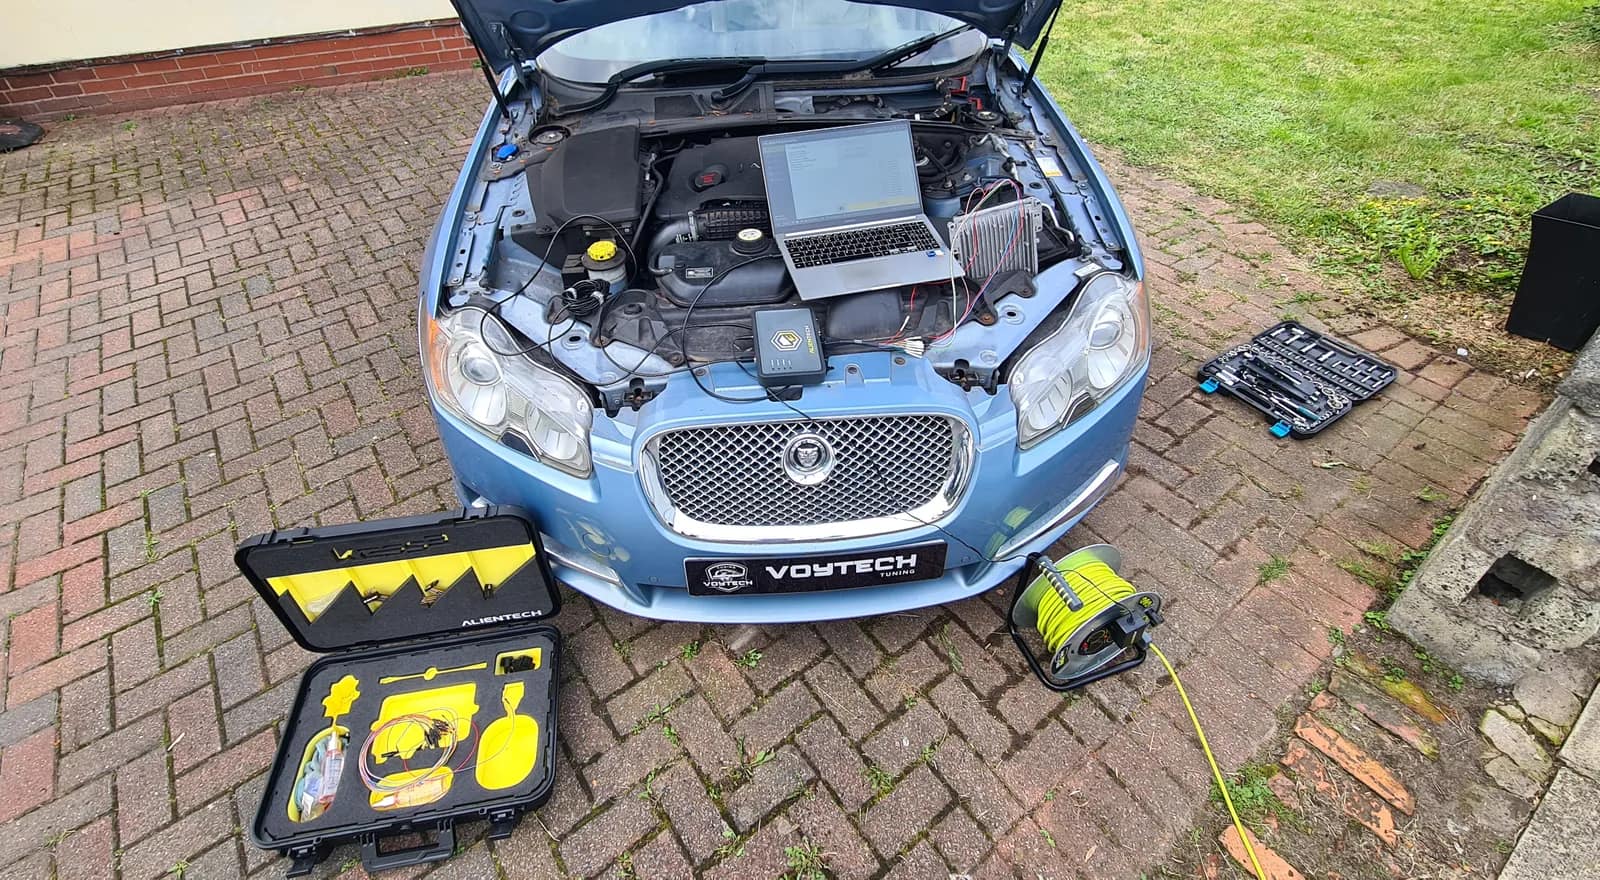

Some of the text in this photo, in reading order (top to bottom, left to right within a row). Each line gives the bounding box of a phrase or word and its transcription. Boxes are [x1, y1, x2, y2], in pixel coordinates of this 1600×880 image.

[765, 553, 918, 579] VOYTECH
[879, 568, 916, 578] TUNING
[461, 609, 543, 627] ALIENTECH
